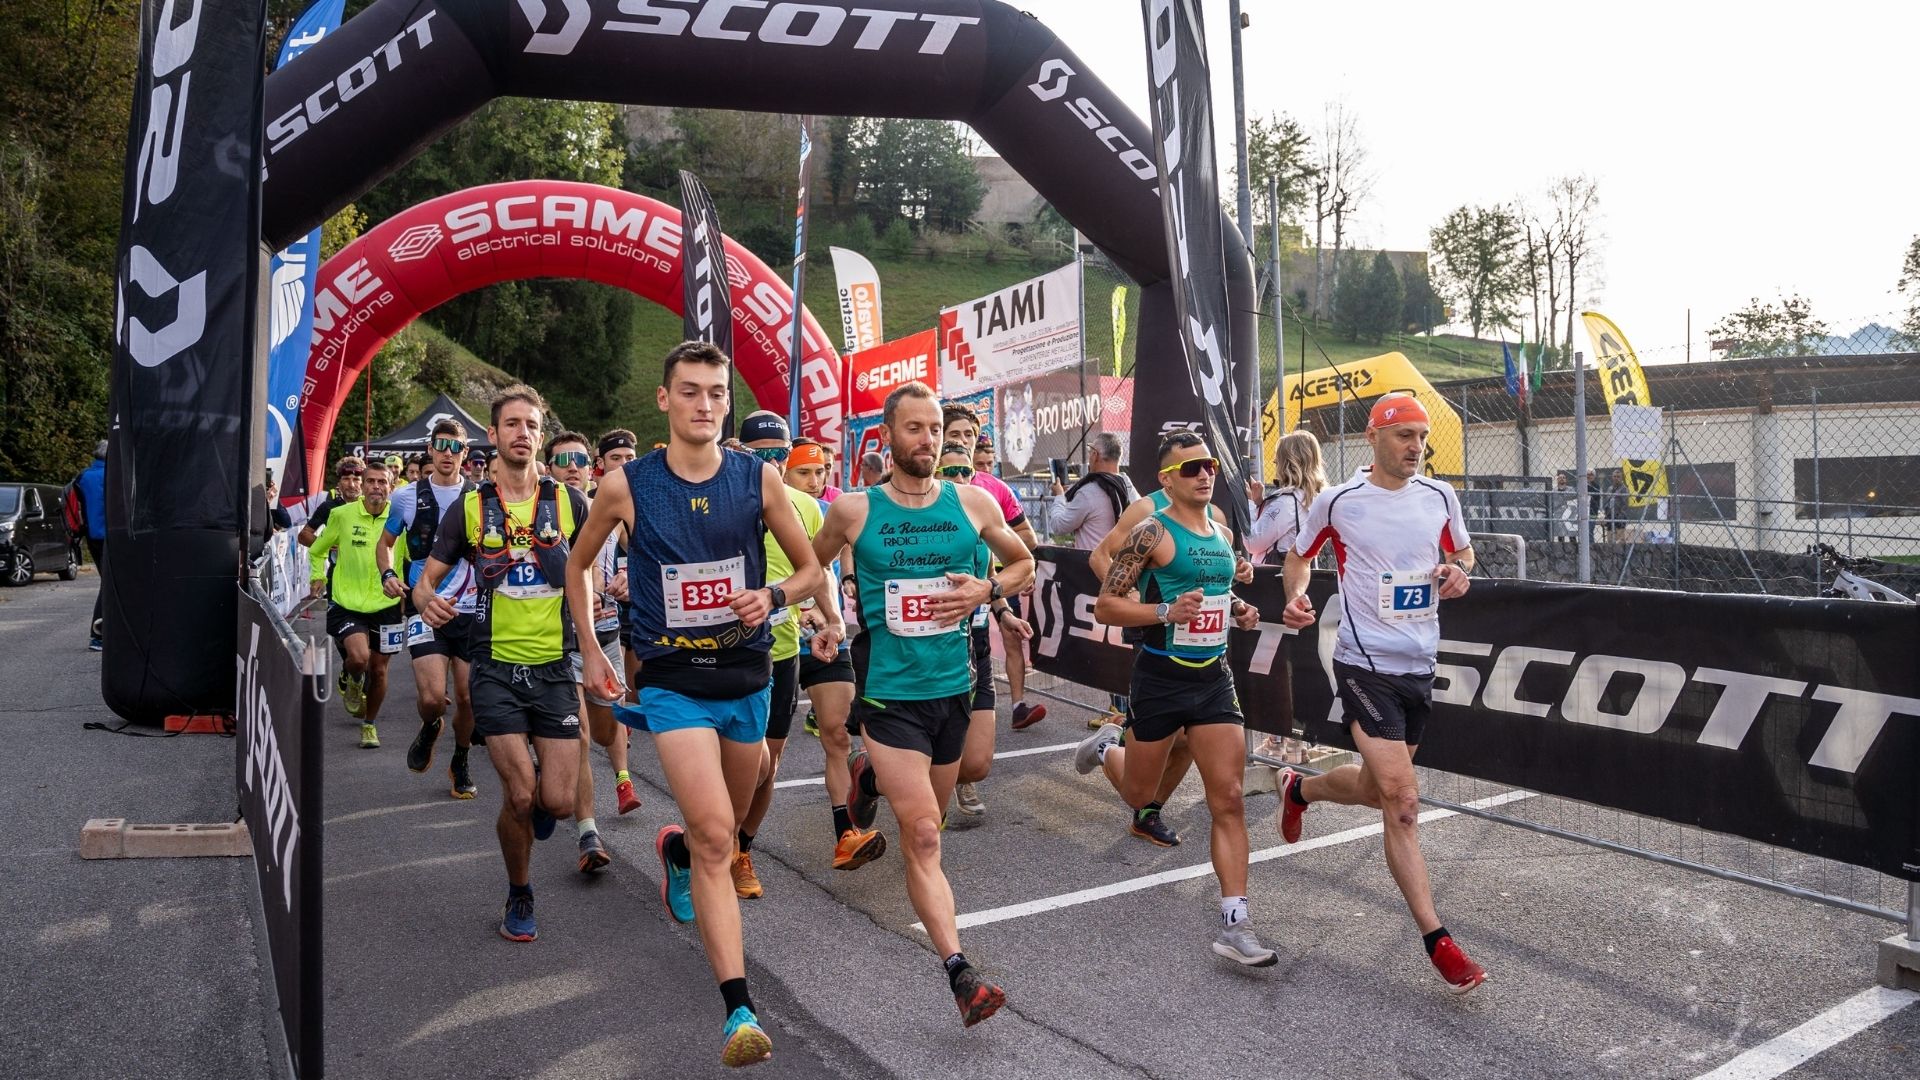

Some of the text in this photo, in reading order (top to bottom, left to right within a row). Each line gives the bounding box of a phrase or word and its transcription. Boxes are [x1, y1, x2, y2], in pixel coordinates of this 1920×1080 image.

[602, 0, 980, 55] SCOTT
[266, 9, 437, 155] SCOTT
[1063, 97, 1161, 198] SCO
[445, 195, 683, 257] SCAME
[457, 231, 673, 273] electrical solutions
[973, 280, 1045, 338] TAMI
[315, 290, 395, 372] solutions
[1052, 330, 1078, 345] Produzione
[869, 353, 928, 390] SCAME
[1036, 406, 1059, 437] PRO
[879, 523, 895, 535] La
[516, 565, 535, 582] 19
[890, 550, 951, 567] Sensitive
[686, 582, 728, 606] 339
[1403, 588, 1423, 606] 73
[1195, 612, 1220, 630] 371
